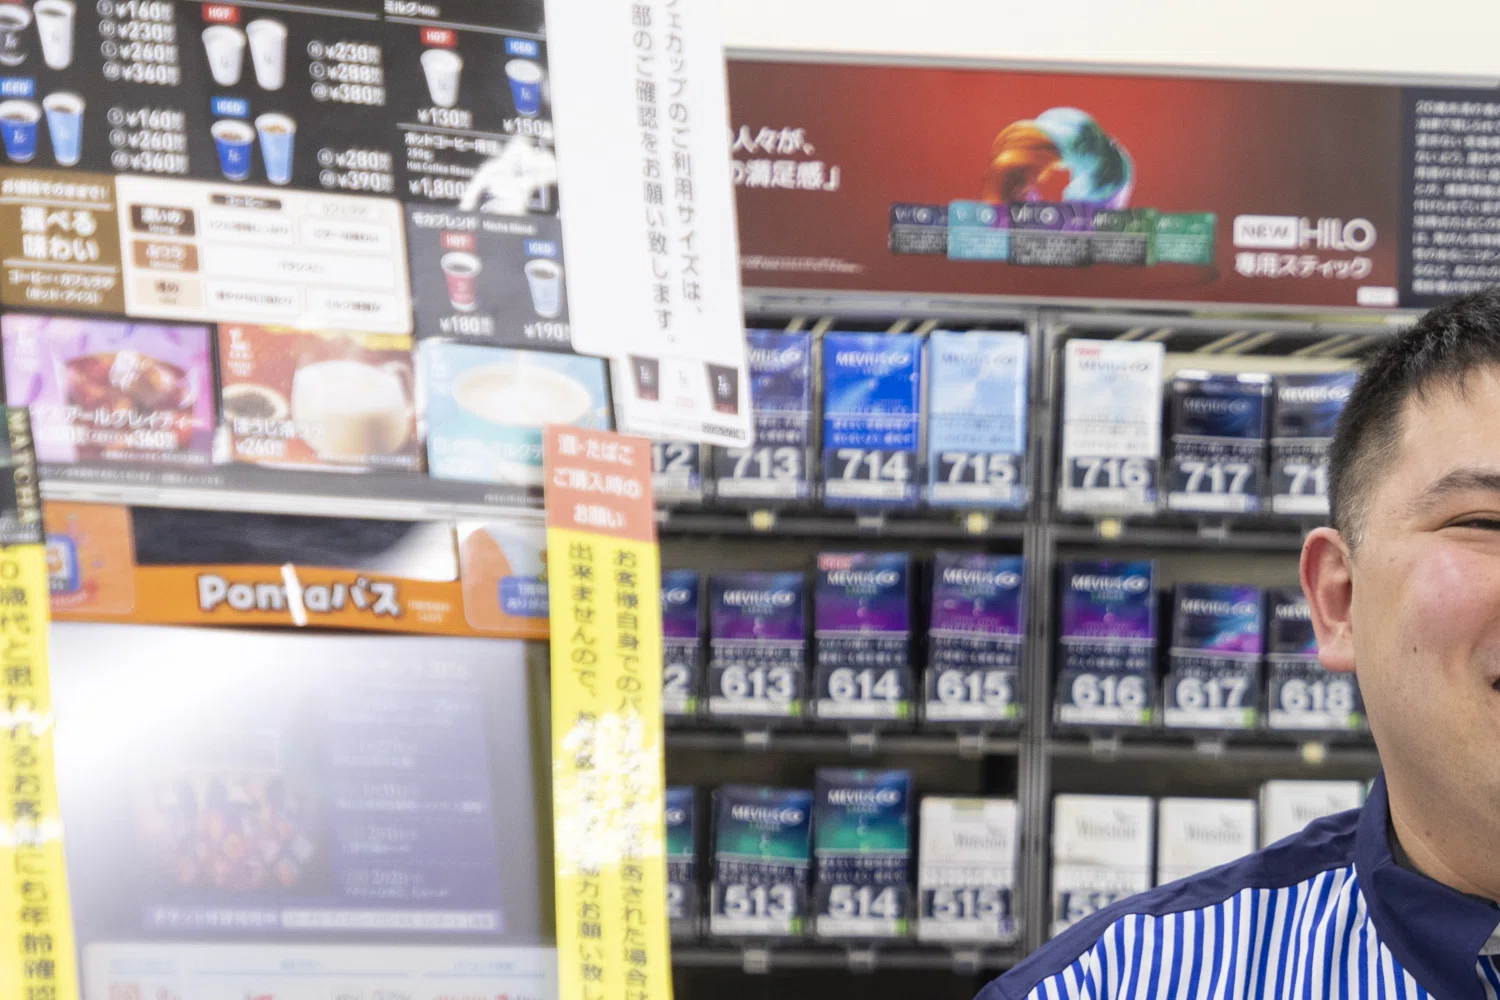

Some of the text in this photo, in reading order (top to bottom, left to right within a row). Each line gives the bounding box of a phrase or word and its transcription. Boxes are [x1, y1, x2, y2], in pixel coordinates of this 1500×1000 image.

[417, 107, 460, 128] ¥130
[732, 125, 816, 157] 人々が、
[408, 177, 466, 199] ¥1,800
[21, 206, 98, 235] 選べる
[1241, 222, 1290, 240] NEW
[23, 236, 99, 263] 味わい
[439, 316, 481, 336] ¥180
[524, 322, 566, 341] ¥190
[727, 449, 799, 481] 713
[837, 449, 911, 482] 714
[942, 452, 1018, 484] 715
[1075, 458, 1150, 488] 716
[1179, 462, 1250, 495] 717
[1283, 464, 1329, 495] 71
[553, 467, 642, 498] ご購入時の
[573, 504, 625, 528] お願い
[721, 666, 795, 700] 613
[828, 669, 901, 701] 614
[937, 669, 1013, 702] 615
[1071, 674, 1147, 709] 616
[1176, 678, 1249, 712] 617
[1280, 679, 1354, 713] 618
[724, 886, 797, 919] 513
[828, 886, 899, 919] 514
[933, 889, 1001, 919] 515
